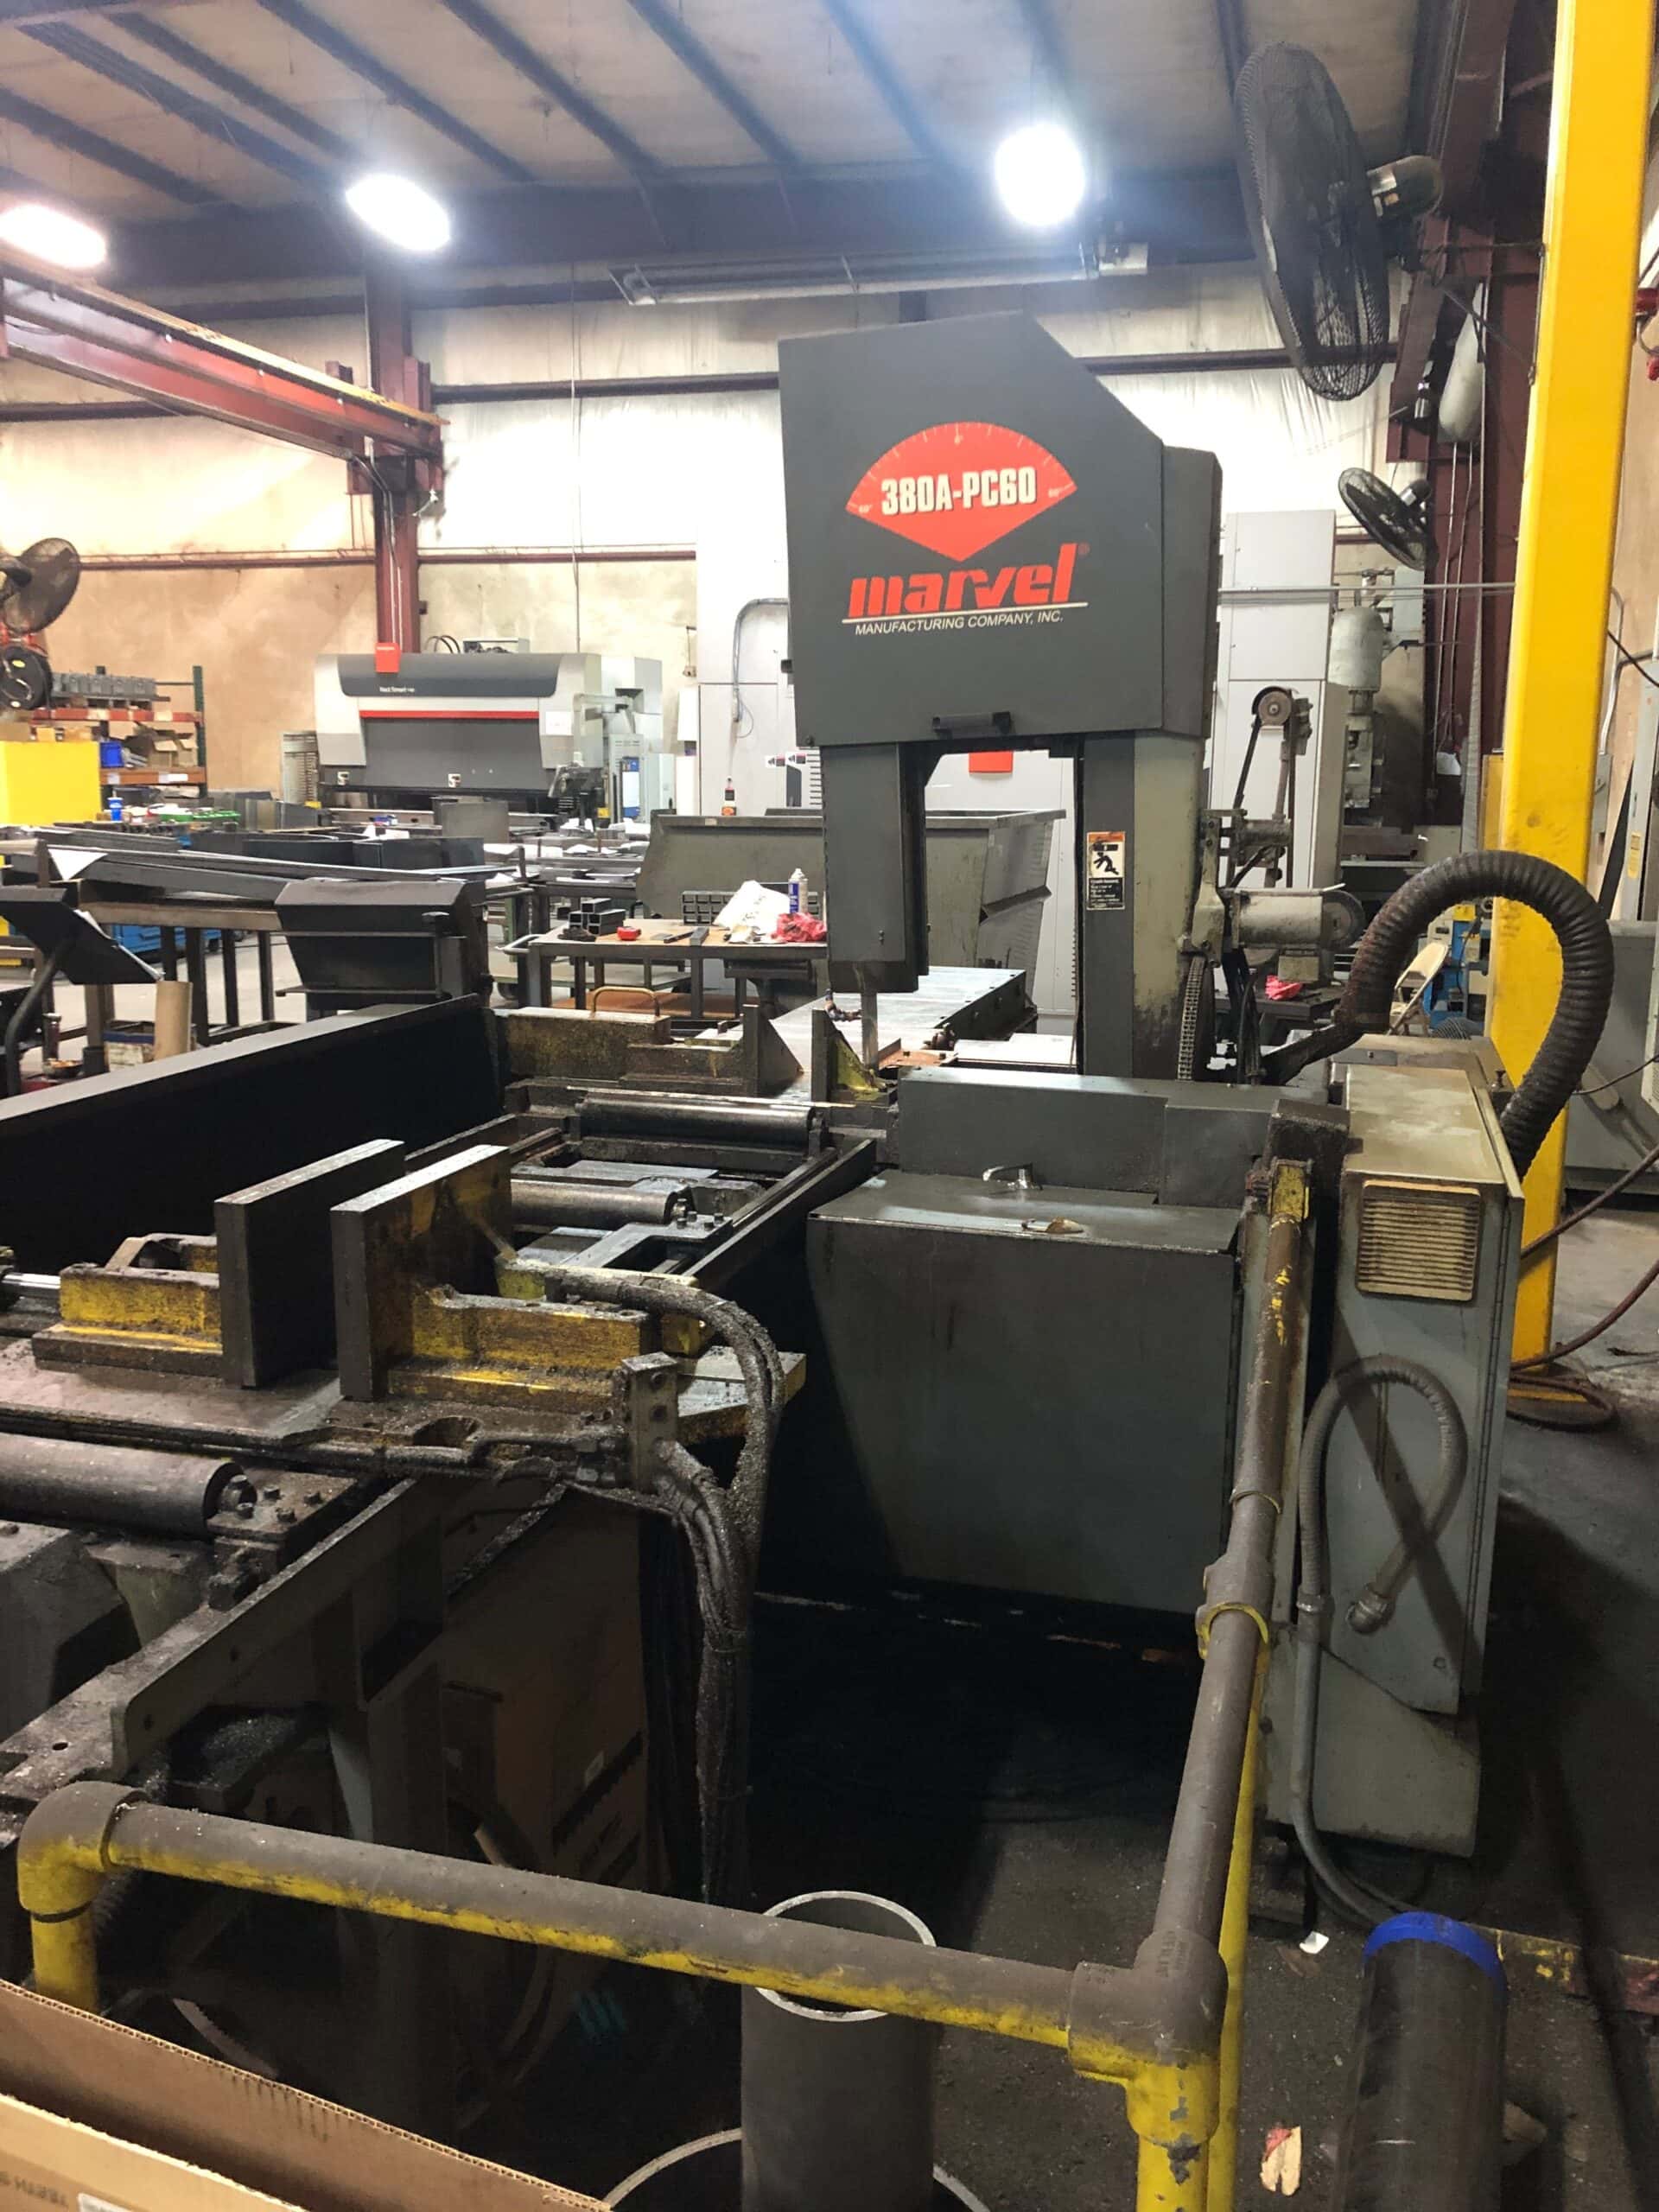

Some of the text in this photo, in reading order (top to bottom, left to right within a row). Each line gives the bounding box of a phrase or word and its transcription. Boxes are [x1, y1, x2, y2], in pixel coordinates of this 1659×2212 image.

[880, 466, 1037, 516] 380A-PC60
[848, 543, 1077, 619] marvel
[855, 609, 1064, 636] MANUFACTURING COMPANY, INC.
